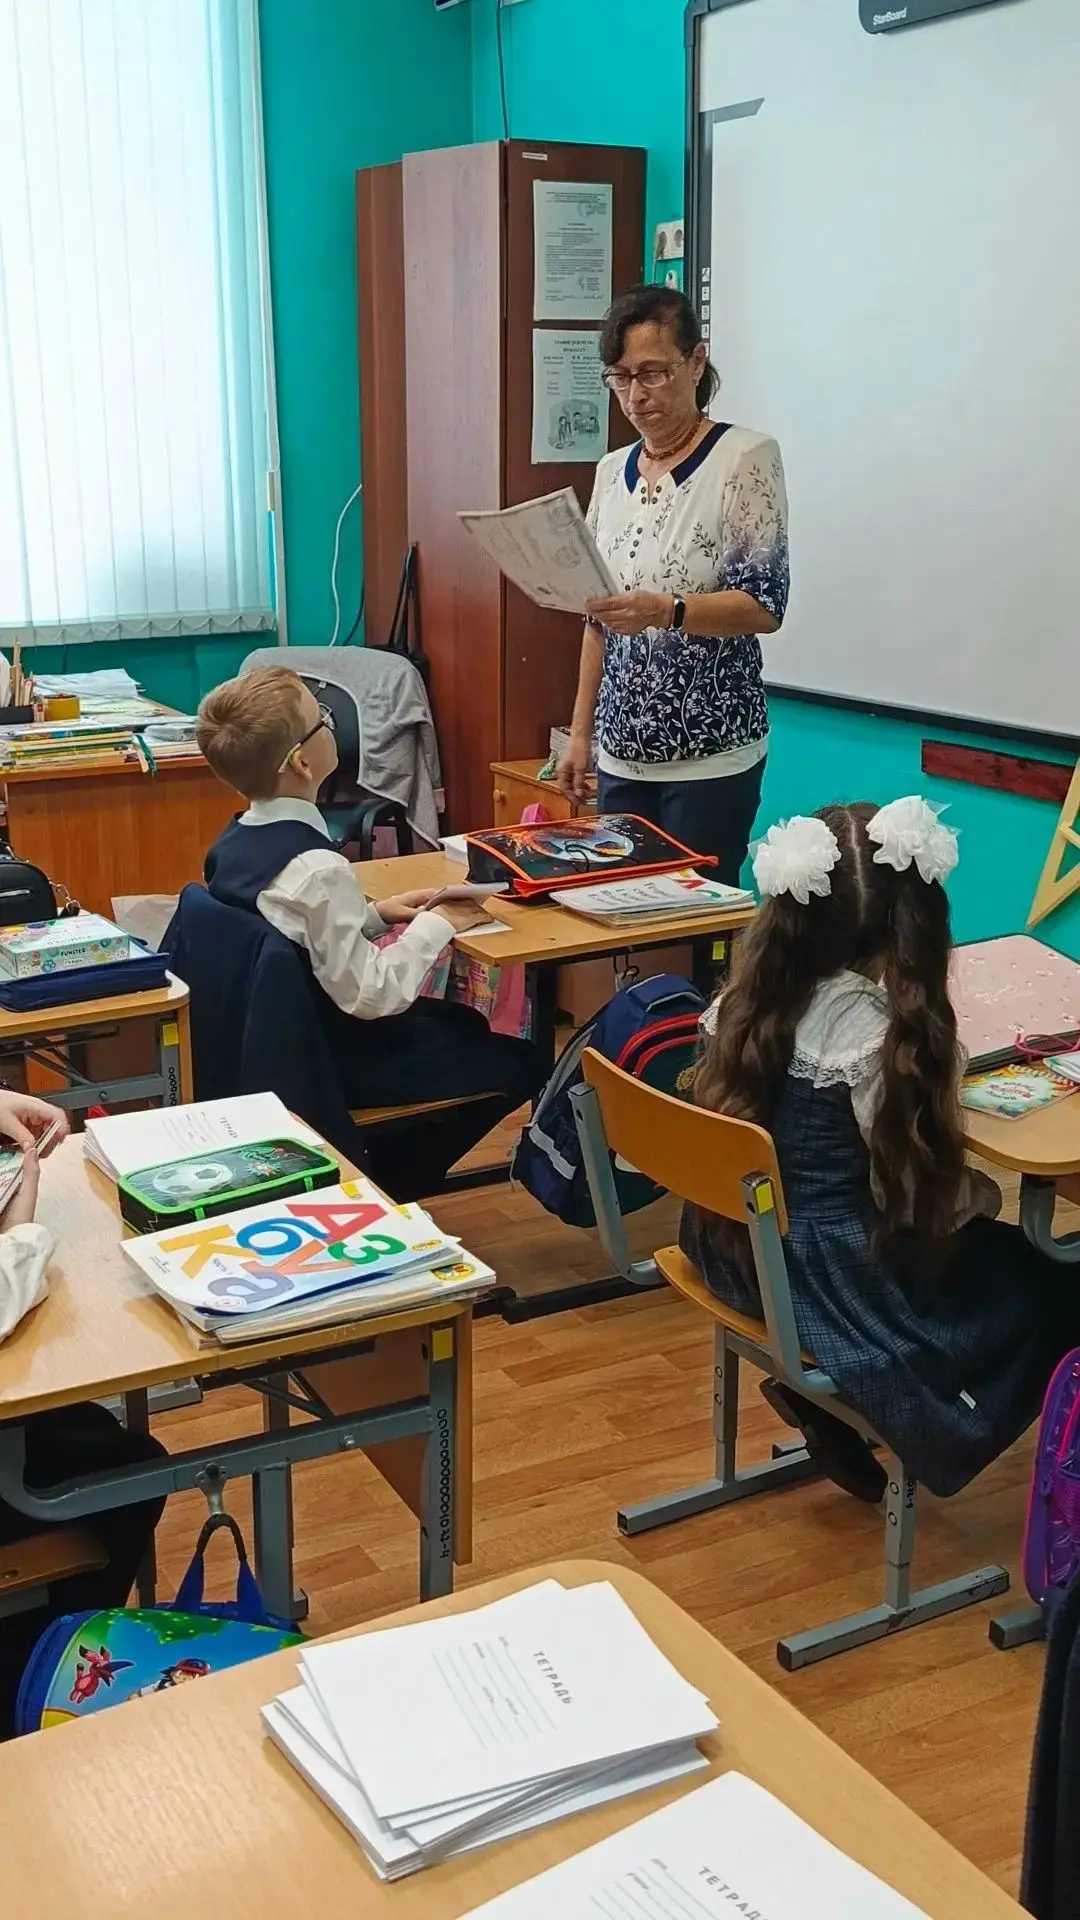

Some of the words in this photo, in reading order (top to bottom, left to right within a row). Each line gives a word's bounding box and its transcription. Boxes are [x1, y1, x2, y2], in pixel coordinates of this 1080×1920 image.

[873, 7, 907, 25] StarBoard
[533, 1650, 573, 1705] ТЕТРАДЬ
[697, 1866, 769, 1920] ТЕТРАД
